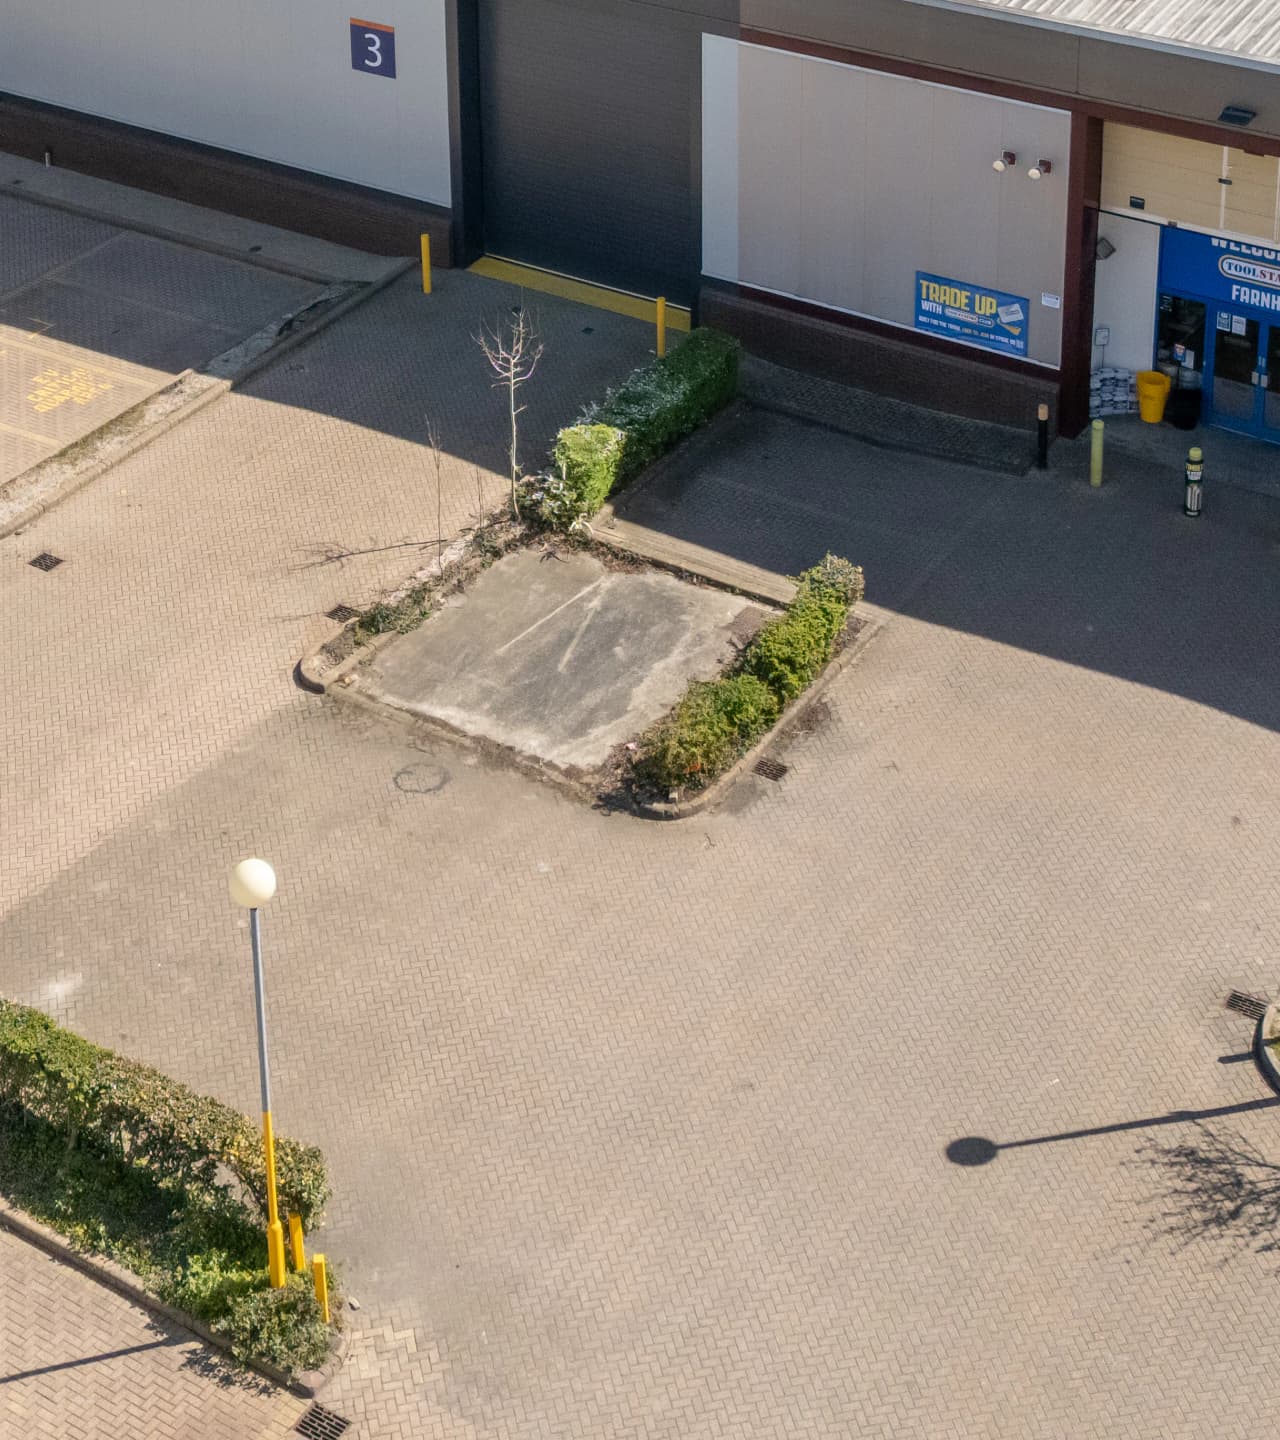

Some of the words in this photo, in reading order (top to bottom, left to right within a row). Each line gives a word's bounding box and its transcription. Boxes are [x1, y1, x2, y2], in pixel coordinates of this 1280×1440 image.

[364, 33, 382, 67] 3
[920, 280, 970, 311] TRADE
[975, 294, 997, 316] UP
[921, 300, 943, 315] WITH
